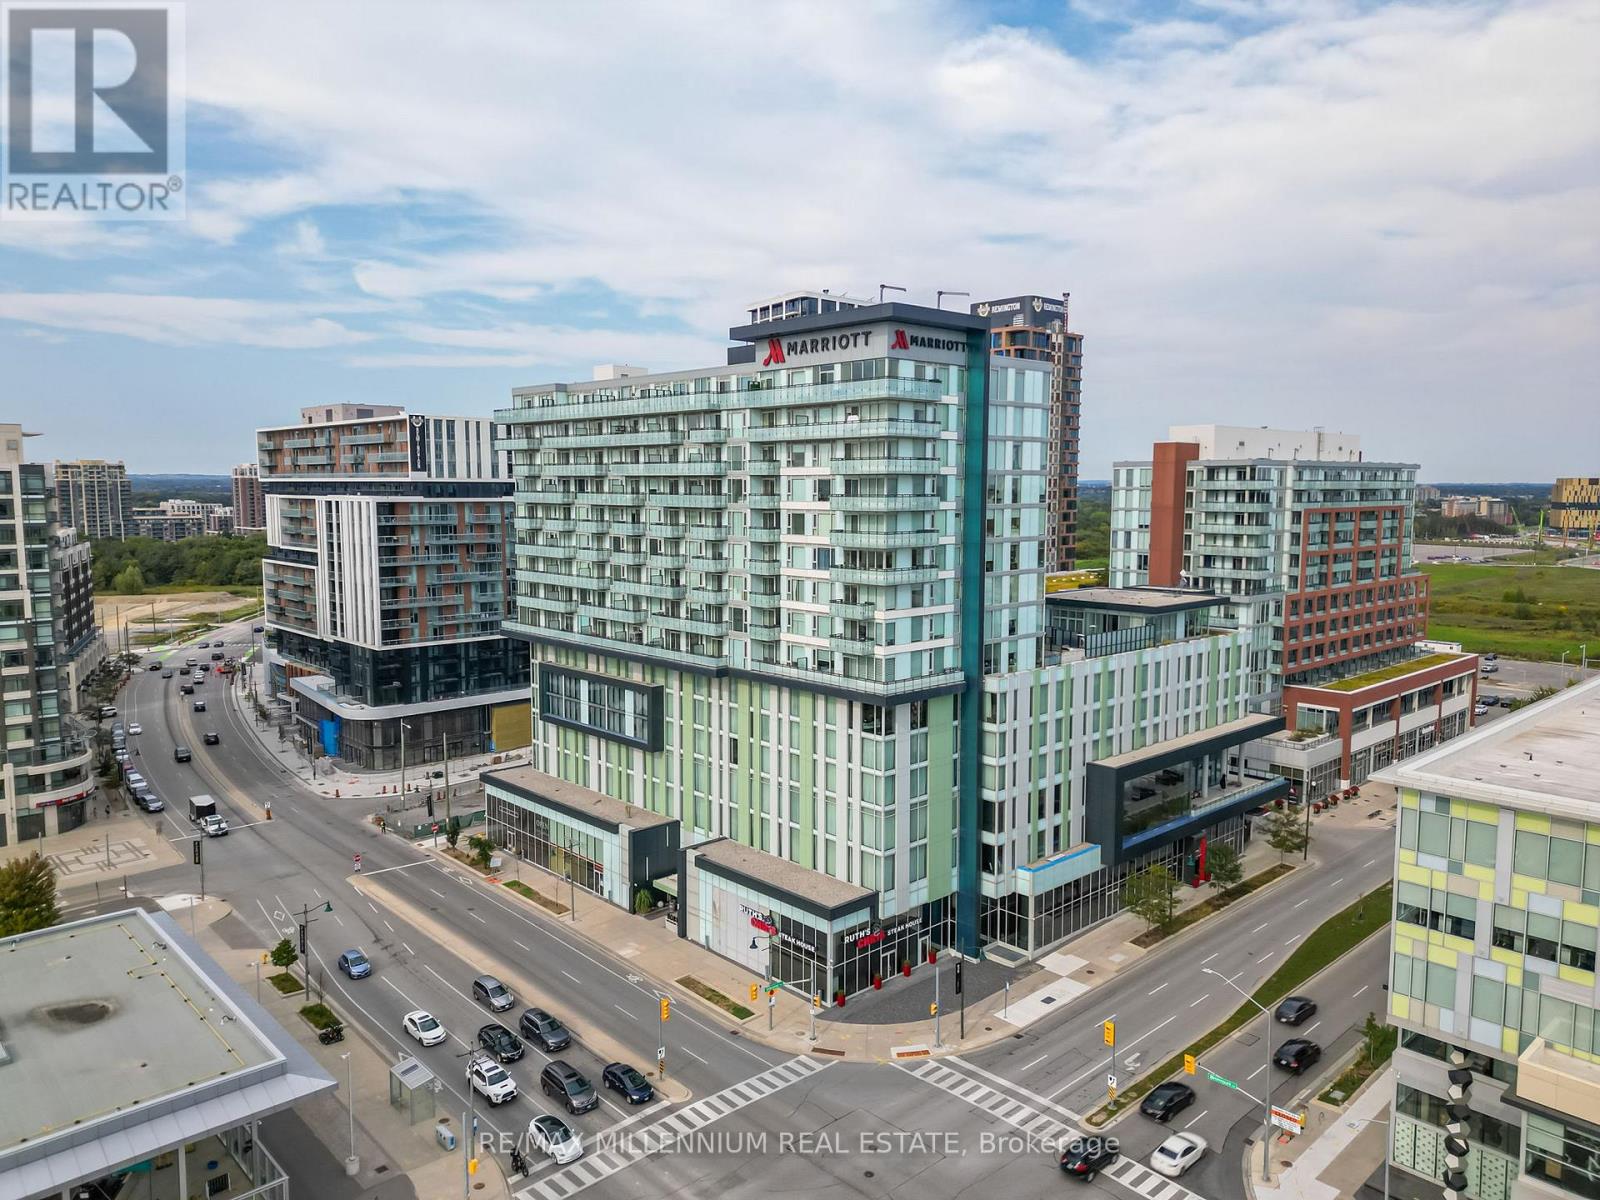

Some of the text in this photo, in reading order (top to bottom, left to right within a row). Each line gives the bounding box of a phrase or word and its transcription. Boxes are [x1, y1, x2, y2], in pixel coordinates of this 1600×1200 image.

[787, 331, 872, 356] MARRIOTT
[910, 335, 968, 353] MARRIOTT
[887, 917, 922, 936] STEAK HOUSE
[844, 928, 870, 944] RUTH'S
[796, 939, 816, 953] HOUSE
